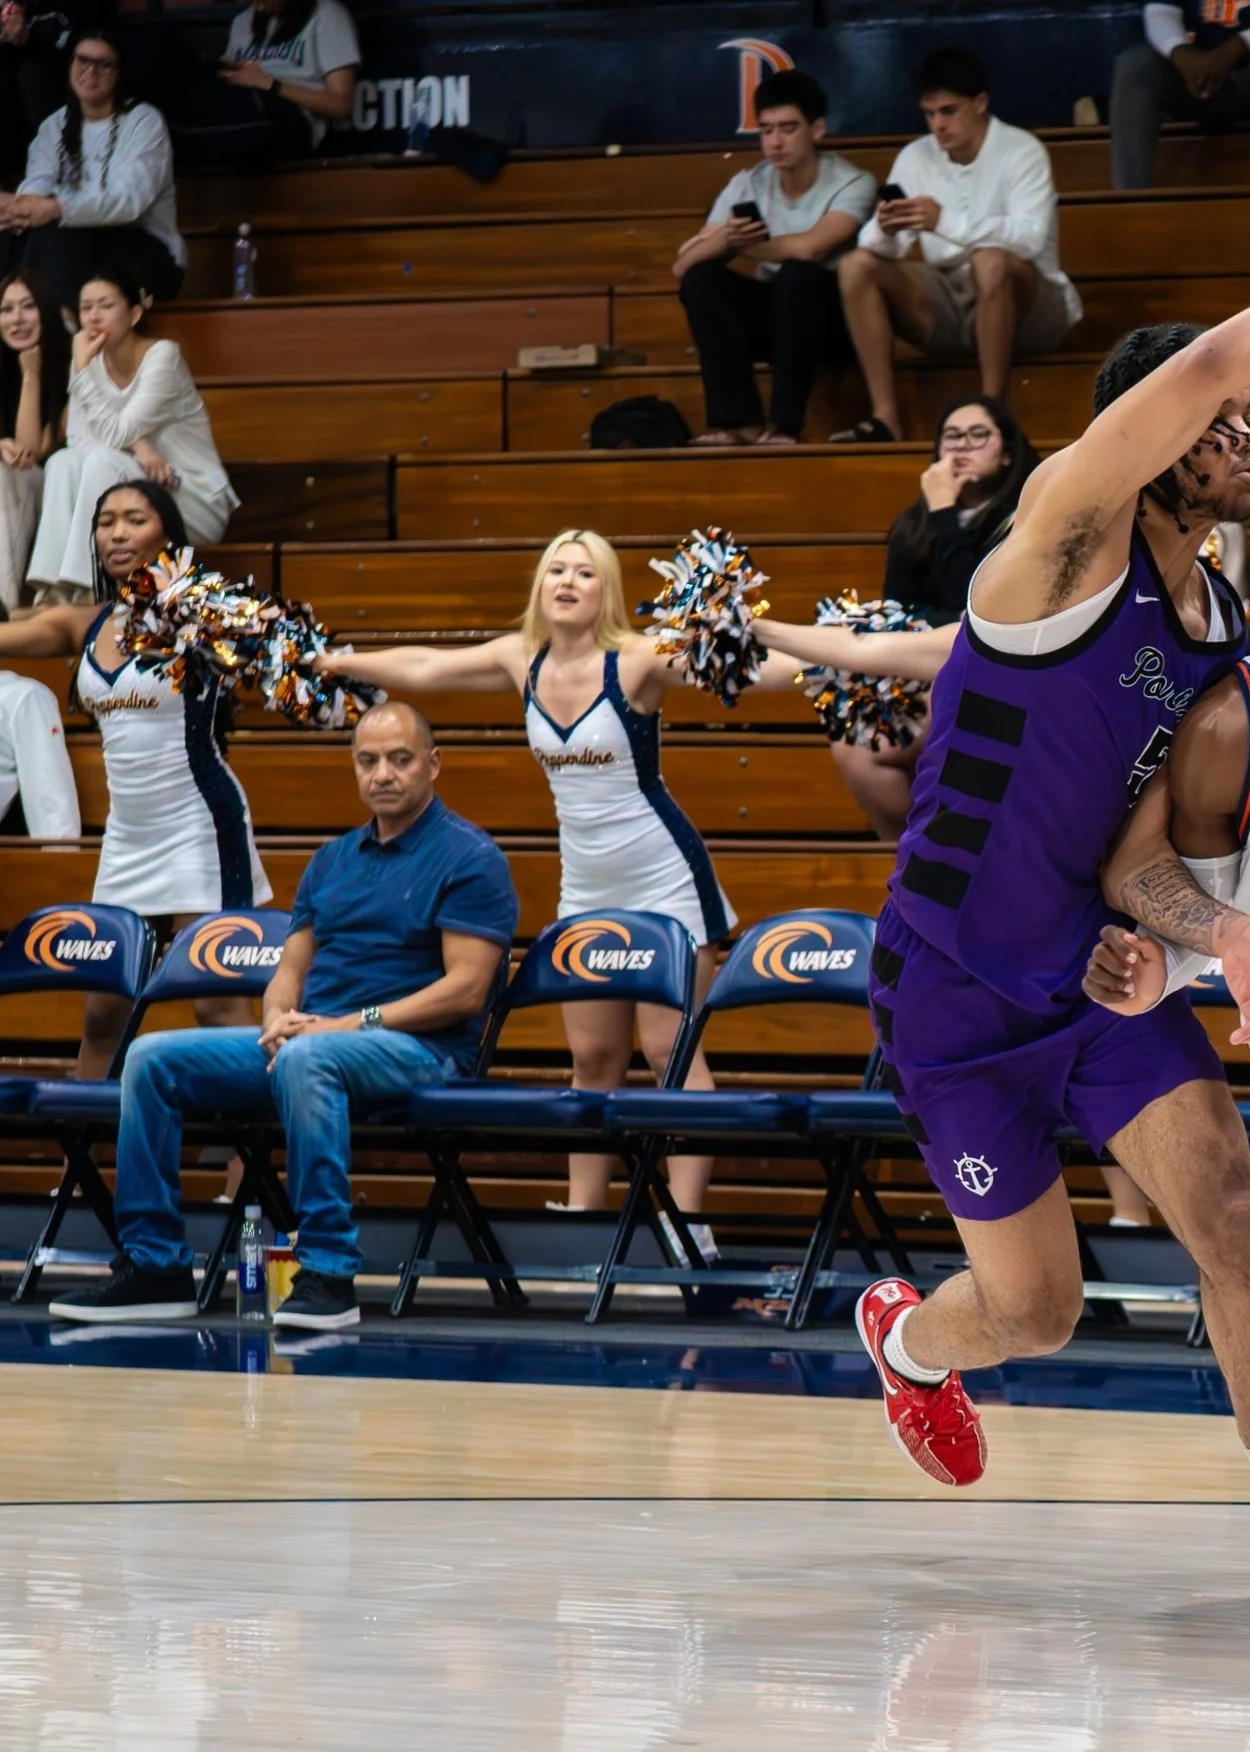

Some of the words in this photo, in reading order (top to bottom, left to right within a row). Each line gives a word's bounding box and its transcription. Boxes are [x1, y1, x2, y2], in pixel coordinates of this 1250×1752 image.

[533, 746, 615, 773] Pepperdine
[55, 939, 116, 961] WAVES
[222, 945, 284, 967] WAVES
[587, 949, 656, 970] WAVES
[788, 949, 857, 971] WAVES
